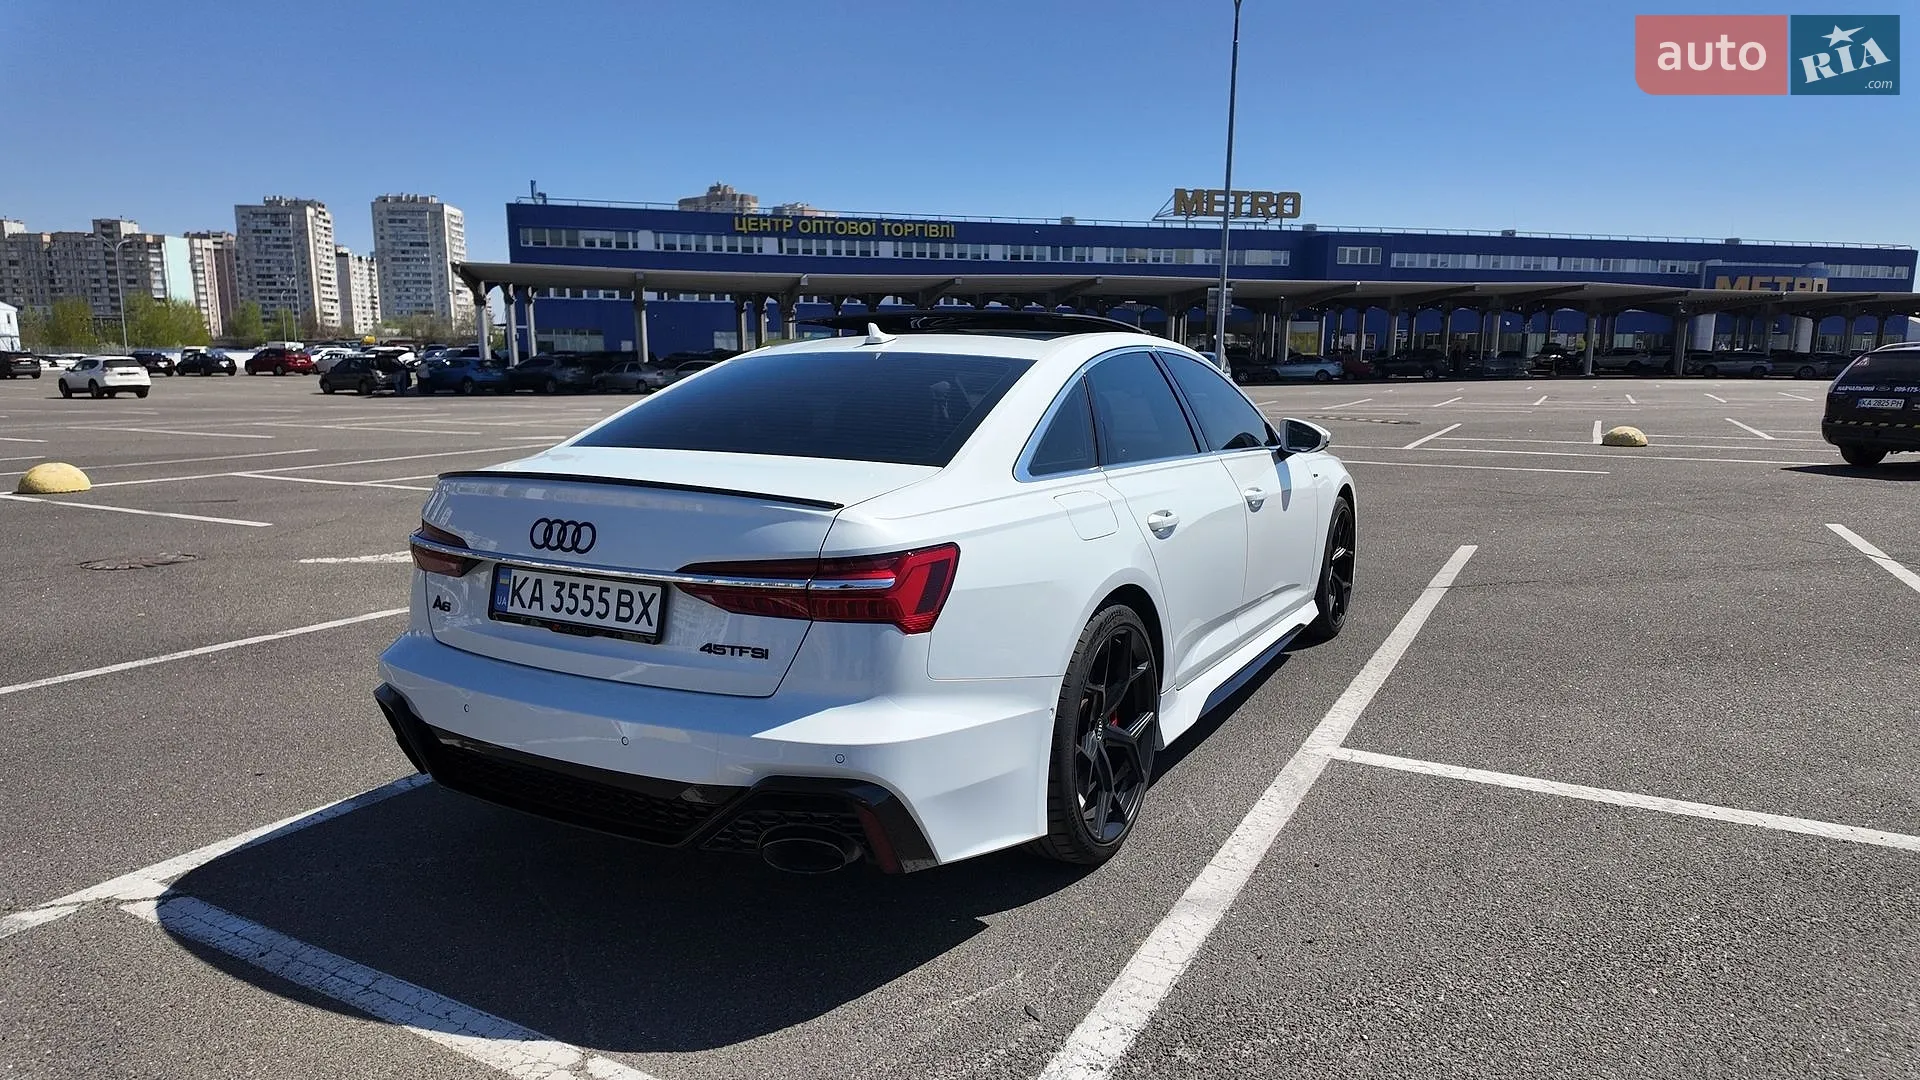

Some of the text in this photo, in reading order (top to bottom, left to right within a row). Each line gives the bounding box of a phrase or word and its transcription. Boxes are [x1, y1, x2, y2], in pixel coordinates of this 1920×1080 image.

[1174, 188, 1302, 219] METRO
[734, 216, 955, 238] ЦЕНТР ОПТОВОЇ ТОРГІВЛІ
[432, 594, 452, 612] A6
[496, 595, 507, 607] UA
[509, 576, 657, 627] KA 3555 BX
[699, 642, 769, 660] 45TFSI
